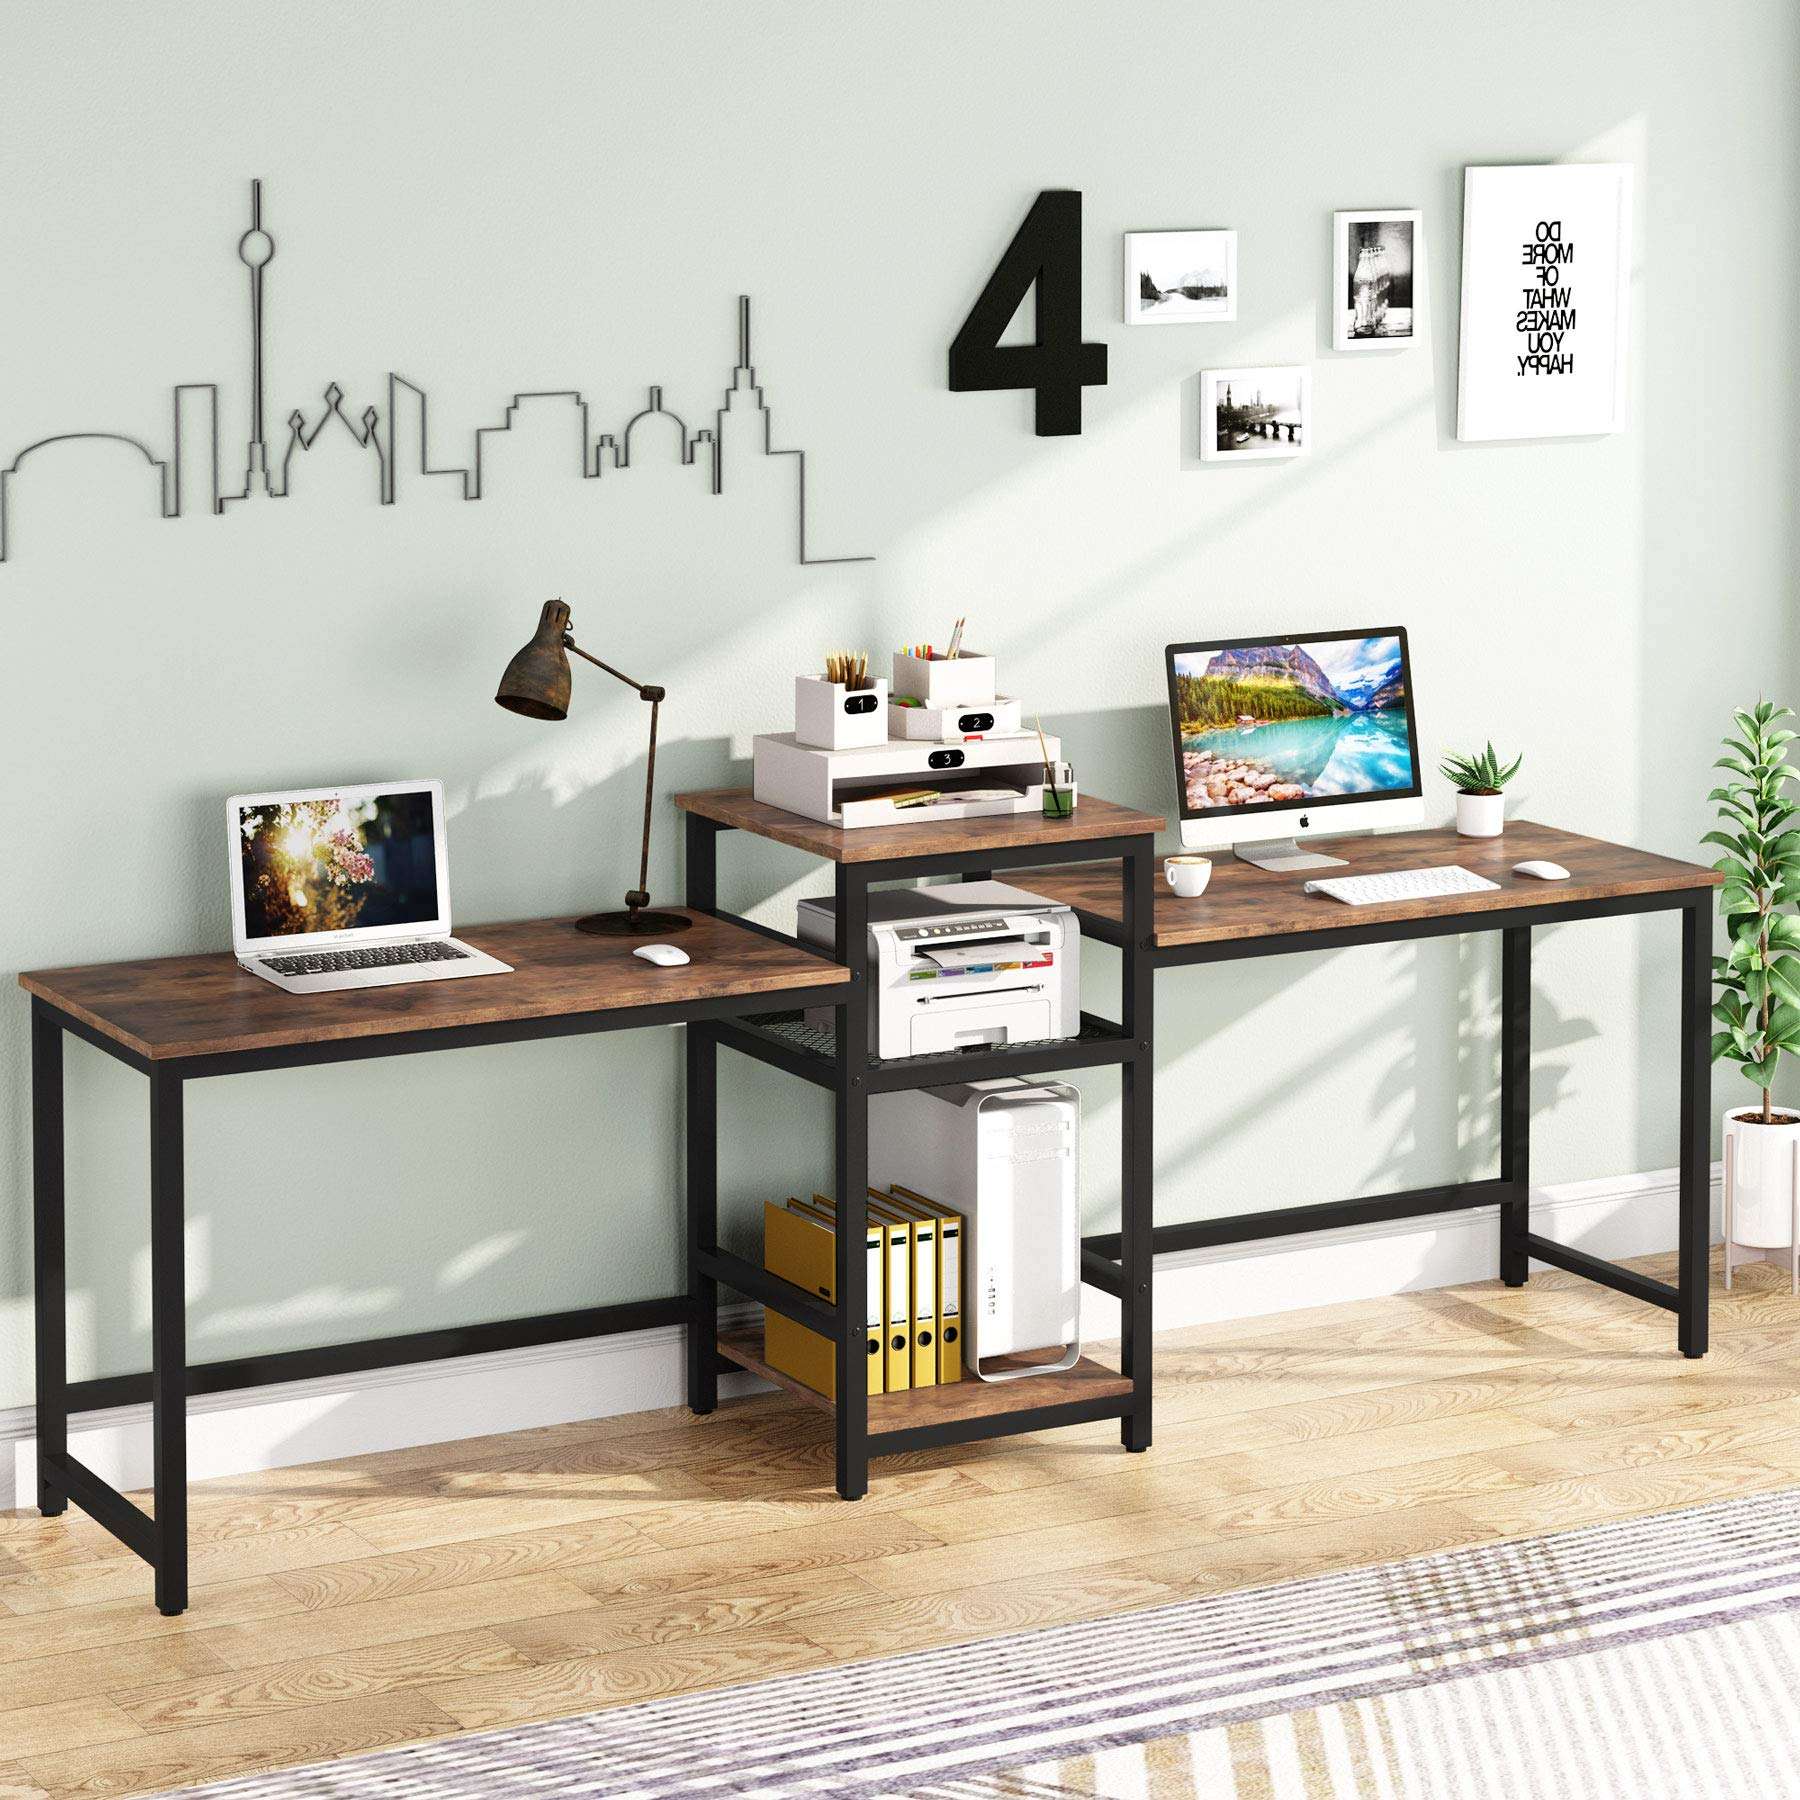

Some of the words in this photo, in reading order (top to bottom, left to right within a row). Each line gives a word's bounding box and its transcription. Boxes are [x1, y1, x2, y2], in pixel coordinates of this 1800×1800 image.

[948, 190, 1108, 437] 4
[858, 699, 864, 711] 1
[973, 717, 981, 728] 2
[944, 753, 951, 765] 3
